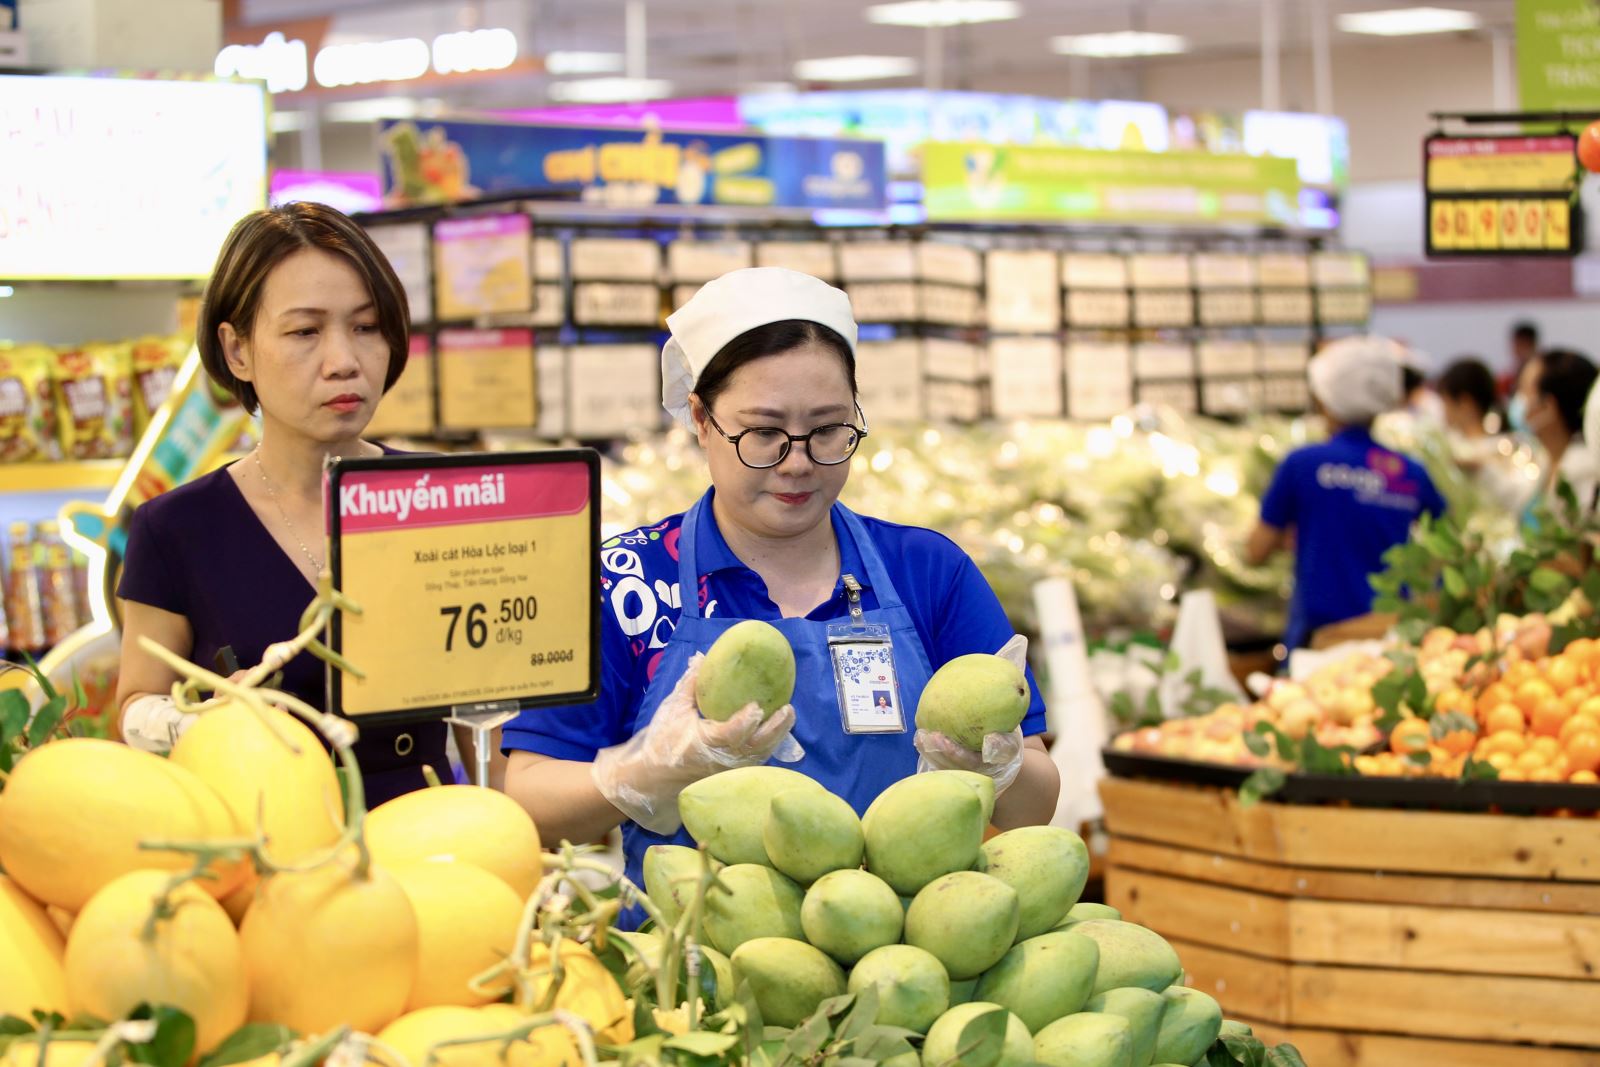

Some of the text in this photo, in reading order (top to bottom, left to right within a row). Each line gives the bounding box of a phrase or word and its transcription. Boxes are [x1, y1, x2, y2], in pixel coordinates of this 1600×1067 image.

[340, 473, 505, 521] Khuyến mãi
[414, 550, 438, 563] Xoài
[441, 548, 458, 561] cát
[486, 543, 505, 558] Lộc
[508, 541, 528, 556] loại
[531, 540, 536, 552] 1
[440, 595, 538, 652] 76 .500
[495, 627, 523, 645] đ/kg
[530, 649, 574, 666] 89.000đ
